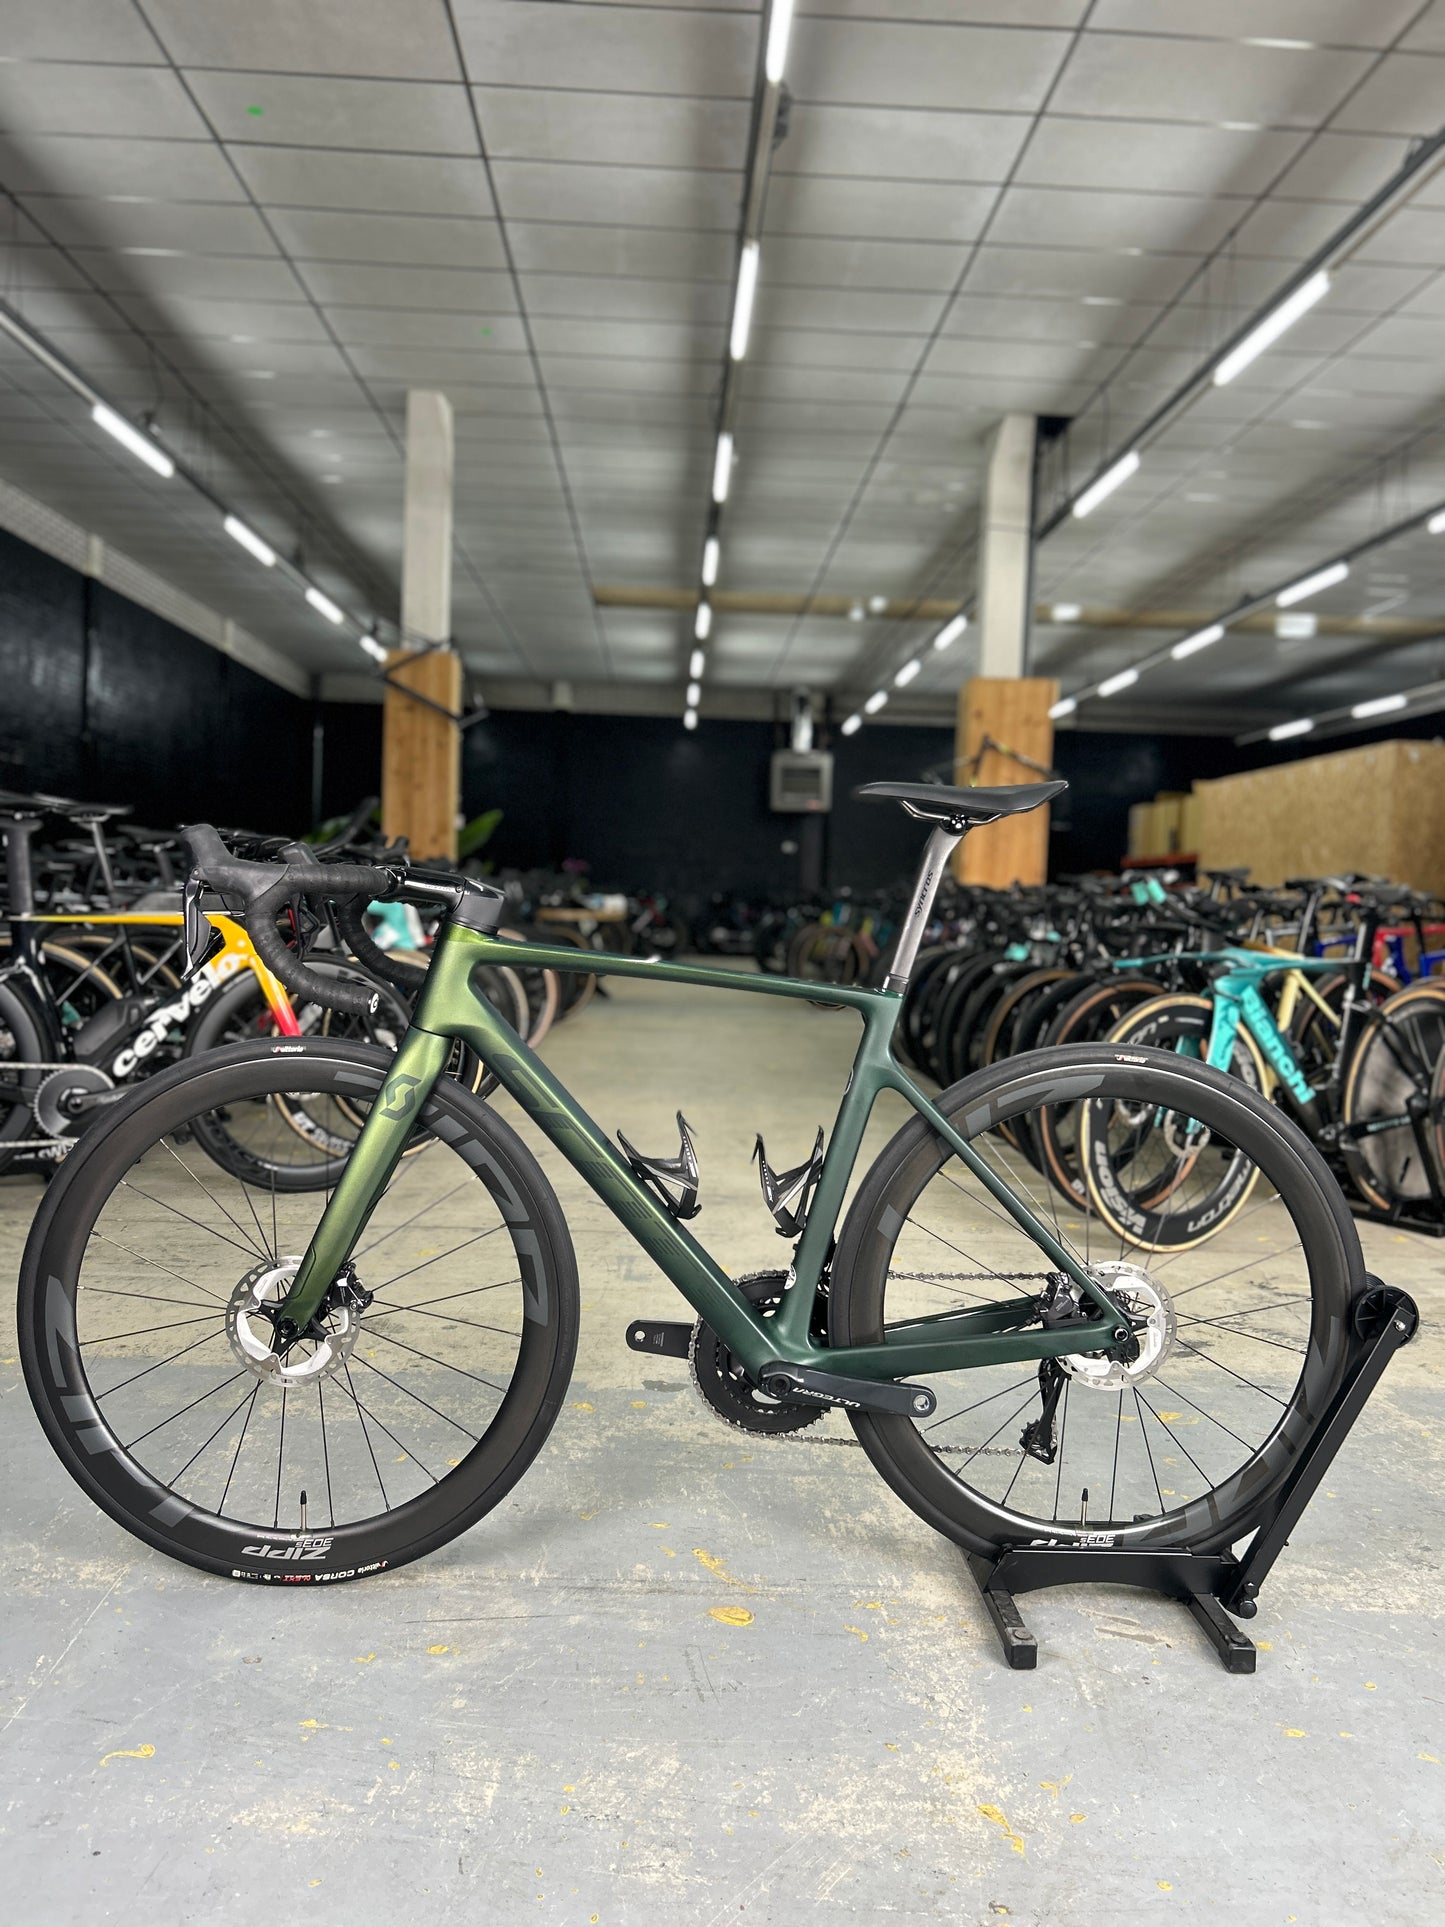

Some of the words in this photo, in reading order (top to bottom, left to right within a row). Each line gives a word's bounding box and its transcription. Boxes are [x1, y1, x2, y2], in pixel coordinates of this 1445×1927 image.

[1240, 985, 1317, 1104] Bianchi
[792, 1387, 861, 1408] ULTEGRA
[241, 1545, 331, 1560] ZIPP
[314, 1569, 355, 1582] CORSA
